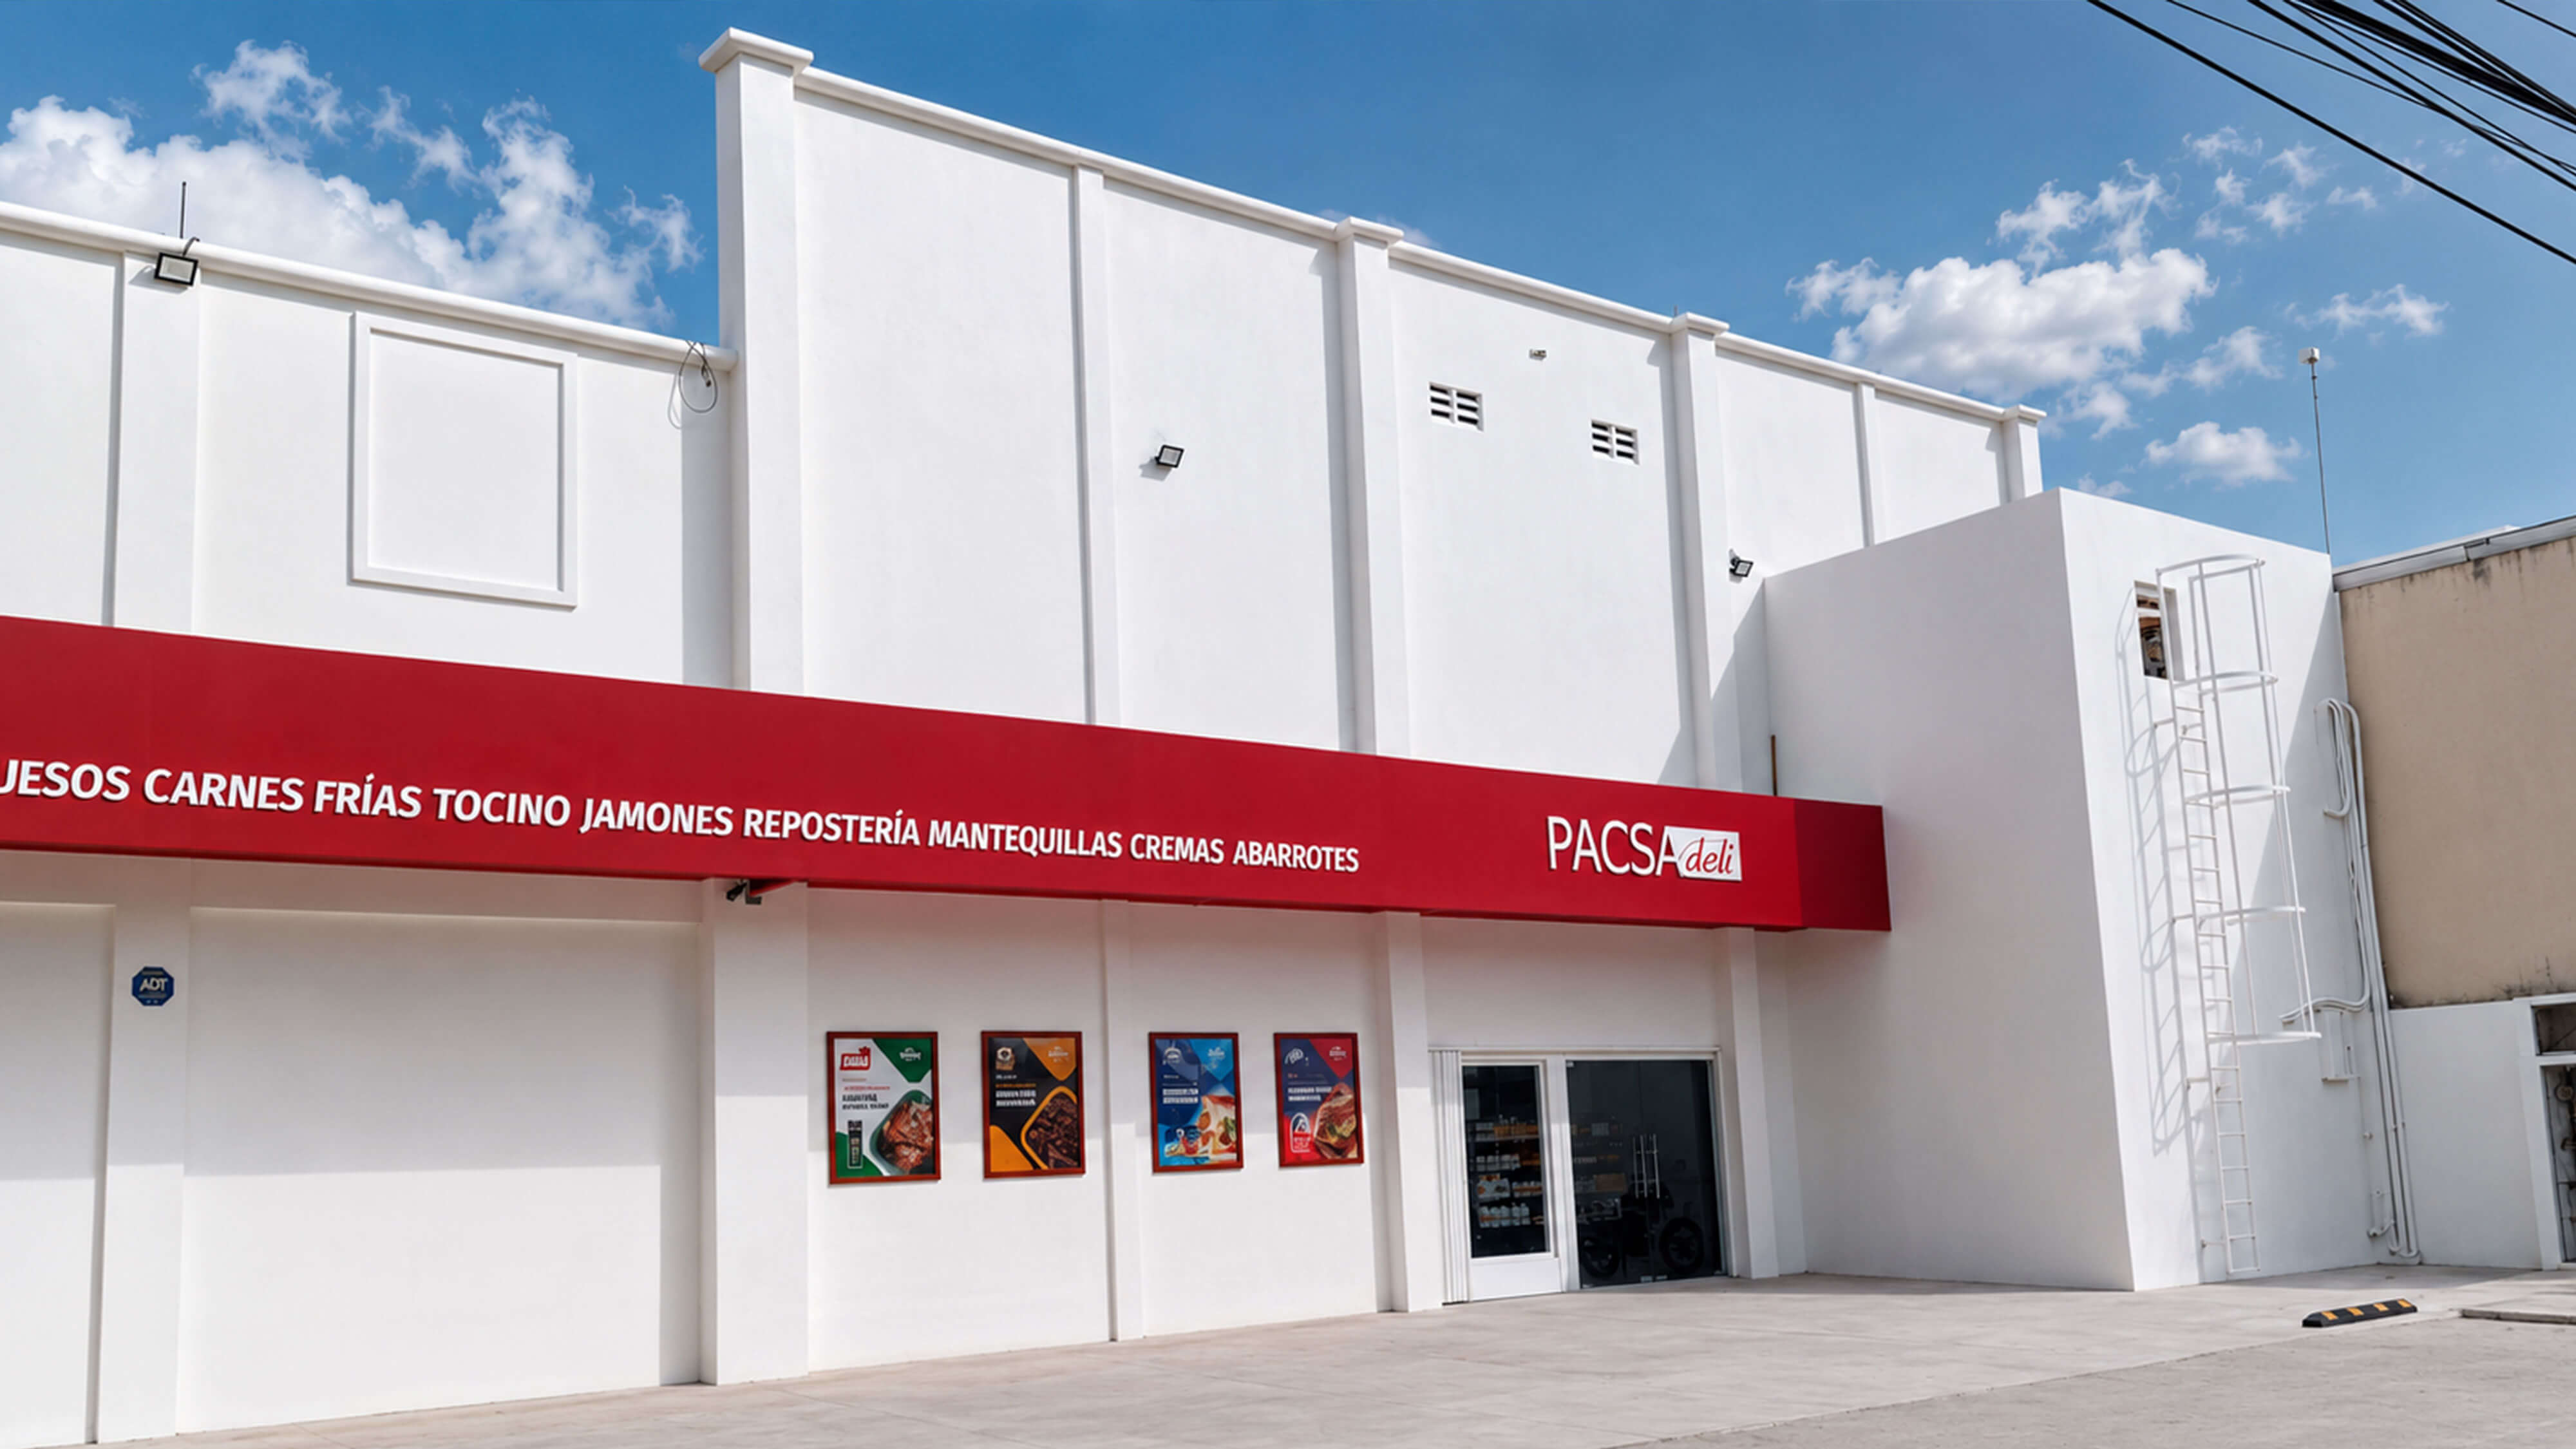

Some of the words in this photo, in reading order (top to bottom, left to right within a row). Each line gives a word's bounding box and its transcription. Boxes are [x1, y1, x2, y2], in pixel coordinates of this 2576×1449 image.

[144, 768, 305, 811] CARNES
[314, 772, 422, 818] FRÍAS
[433, 788, 571, 826] TOCINO
[579, 798, 734, 836] JAMONES
[743, 809, 921, 846] REPOSTERÍA
[927, 819, 1122, 858] MANTEQUILLAS
[1130, 833, 1225, 864] CREMAS
[1232, 840, 1359, 873] ABARROTES
[1548, 815, 1685, 878] PACSA
[1685, 837, 1734, 875] deli
[139, 977, 169, 992] ADT
